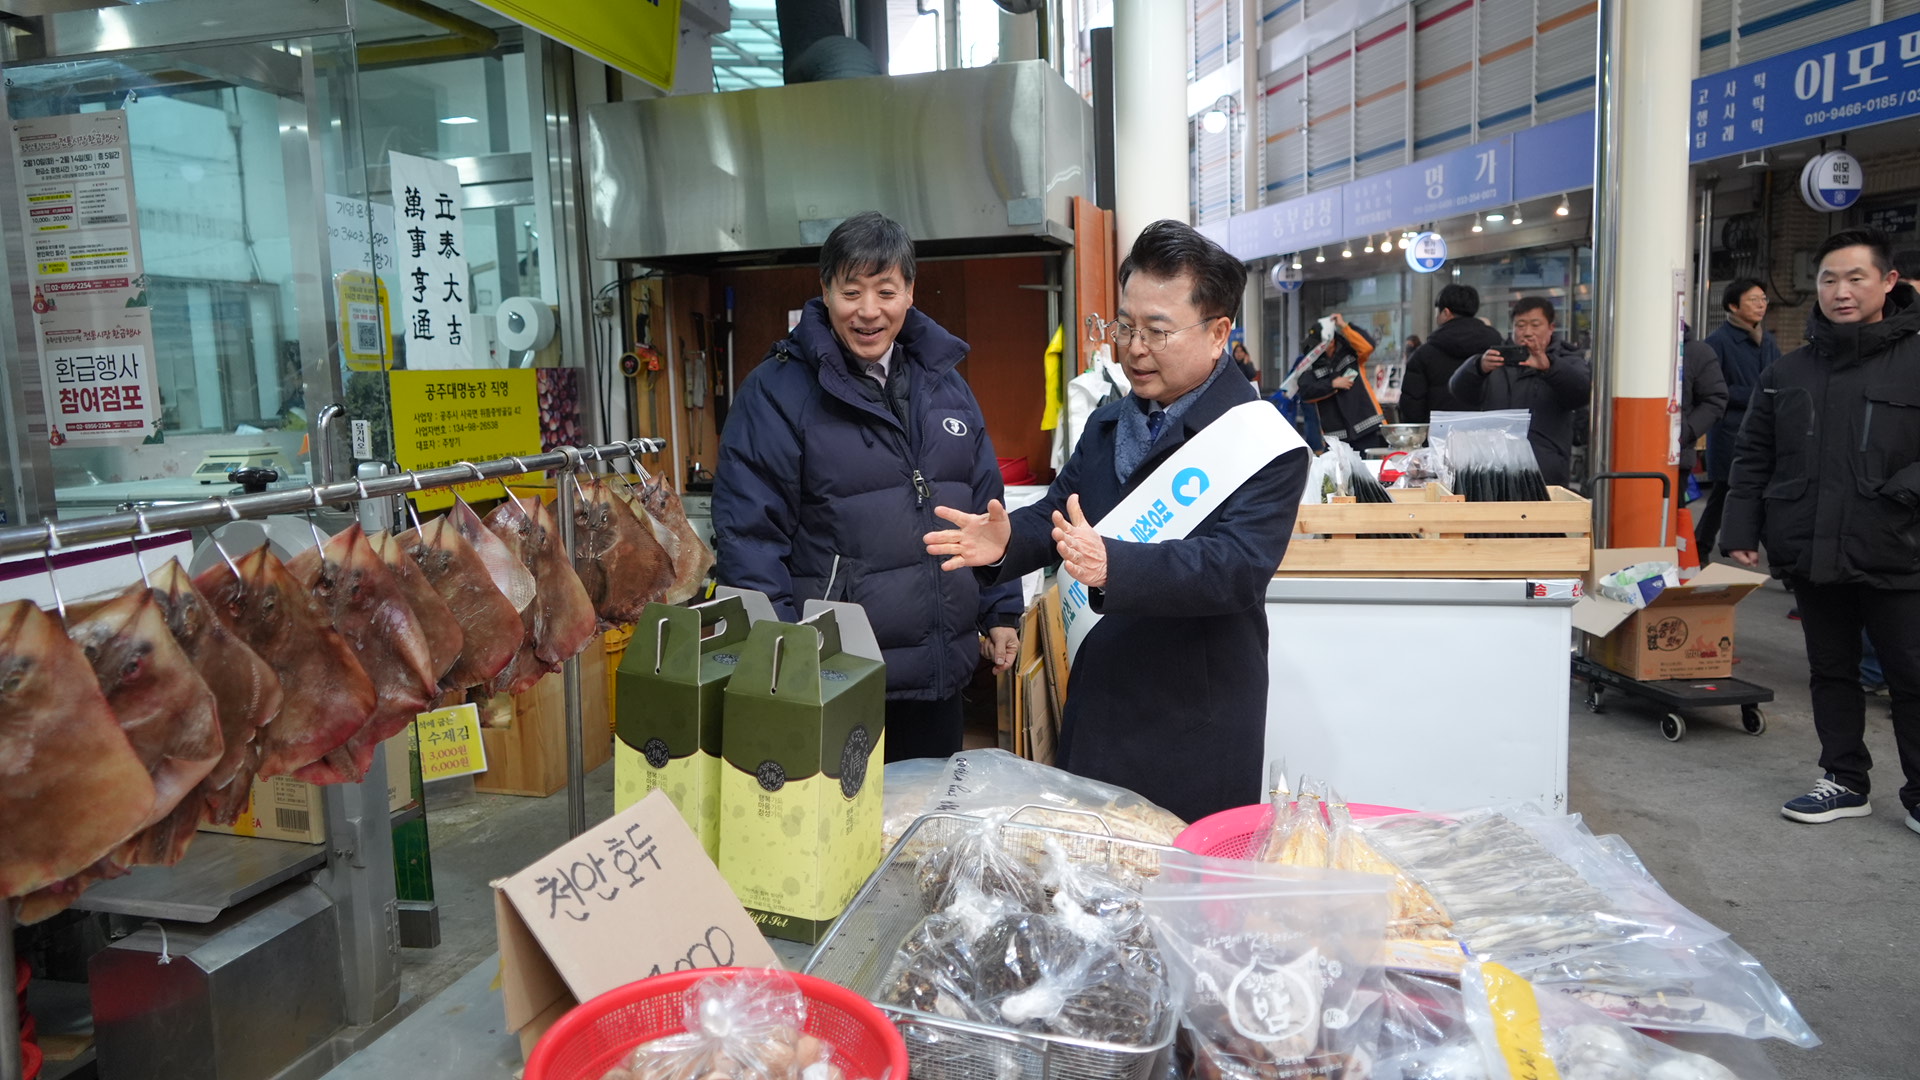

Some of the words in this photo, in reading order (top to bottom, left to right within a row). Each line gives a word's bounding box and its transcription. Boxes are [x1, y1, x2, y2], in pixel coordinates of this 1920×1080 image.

[1805, 92, 1898, 126] 010-9466-0185
[94, 162, 109, 170] 17:00
[1833, 162, 1849, 173] 이모
[435, 192, 463, 346] 立春大吉
[112, 328, 141, 339] 환급행사
[54, 353, 139, 383] 환급행사
[59, 385, 144, 414] 참여점포
[425, 382, 487, 401] 공주대명농장
[491, 380, 509, 397] 직영
[414, 412, 433, 423] 사업장
[440, 410, 458, 421] 공주시
[356, 423, 365, 449] 당기시오
[415, 425, 447, 437] 사업자번호
[416, 440, 436, 451] 대표자
[1130, 499, 1175, 543] 명절
[428, 725, 470, 746] 수제김
[430, 745, 468, 760] 3,000원
[431, 757, 470, 773] 6,000원
